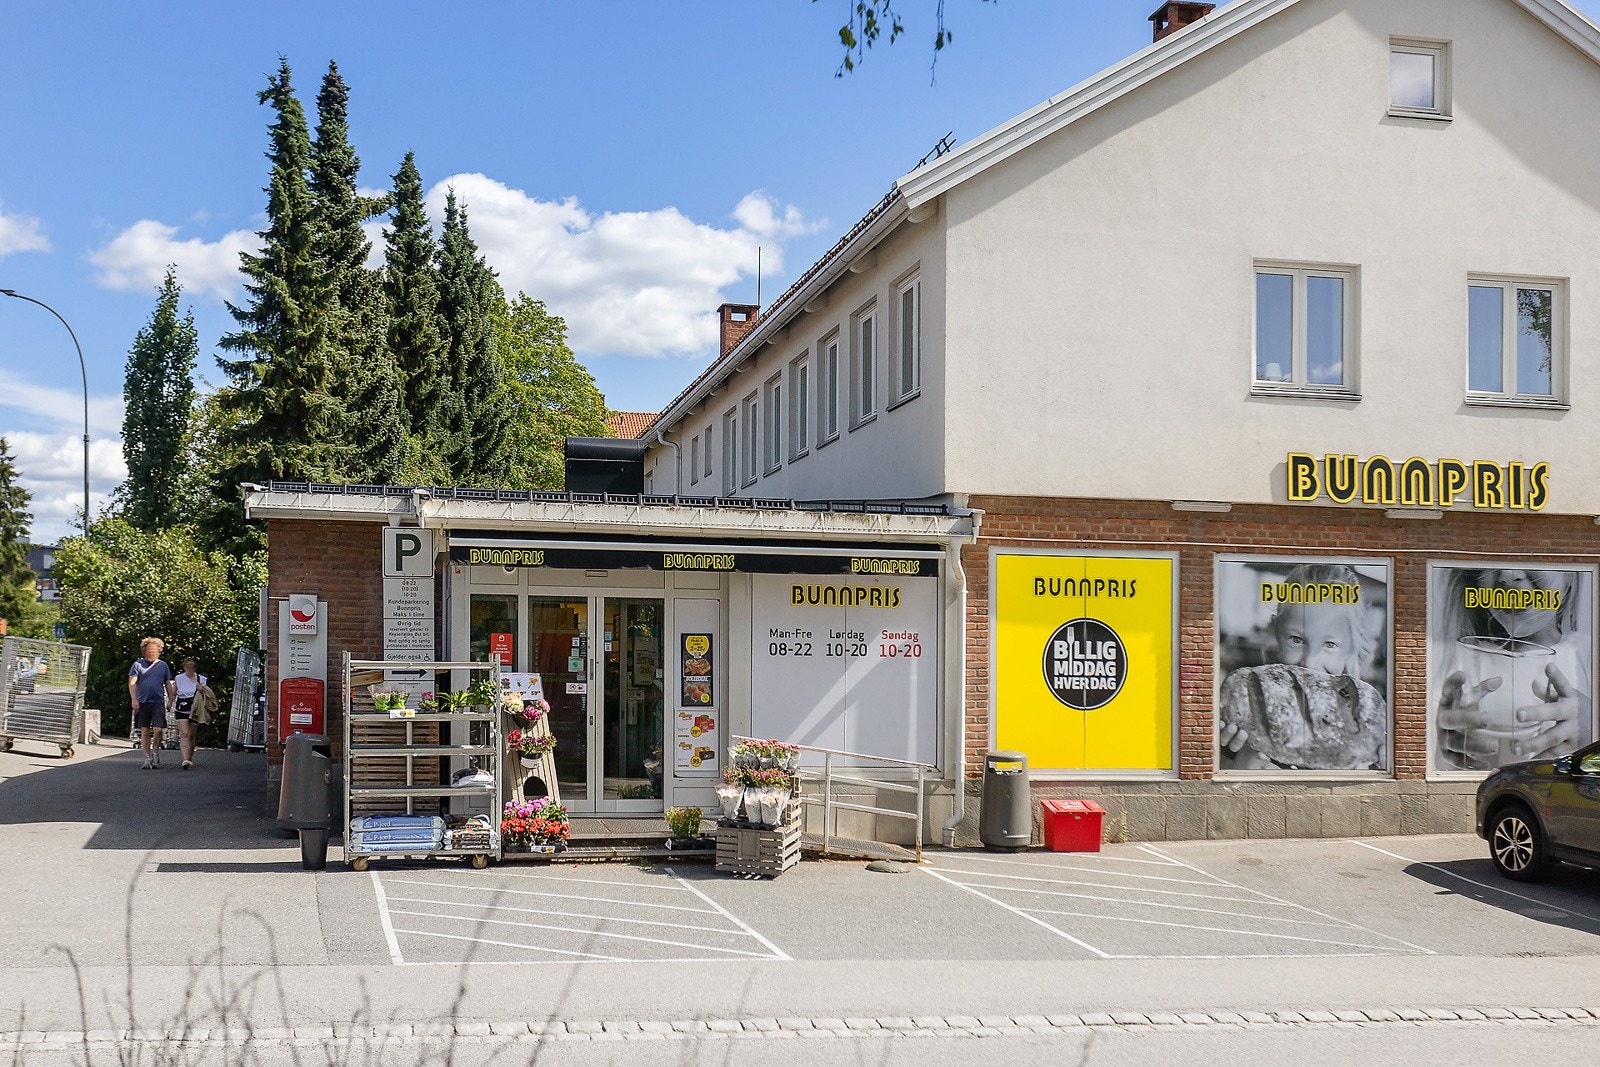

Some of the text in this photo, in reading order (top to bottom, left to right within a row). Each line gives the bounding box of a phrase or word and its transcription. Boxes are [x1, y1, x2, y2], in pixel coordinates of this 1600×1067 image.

[1287, 452, 1550, 511] BUNNPRIS
[395, 533, 421, 571] P
[469, 549, 545, 565] BUNNPRIS
[663, 553, 735, 569] BUNNPRIS
[851, 558, 920, 574] BUNNPRIS
[790, 583, 901, 608] BUNNPRIS
[1034, 577, 1136, 598] BUNNPRIS
[1261, 582, 1361, 604] BUNNPRIS
[1465, 587, 1561, 610] BUNNPRIS
[290, 623, 315, 632] posten
[769, 629, 919, 642] Man-Fre Lørdag Søndag
[769, 643, 922, 658] 08-22 10-20 10-20
[1053, 637, 1117, 660] BILLIG
[1053, 660, 1117, 676] MIDDAG
[1053, 676, 1117, 690] HVERDAG
